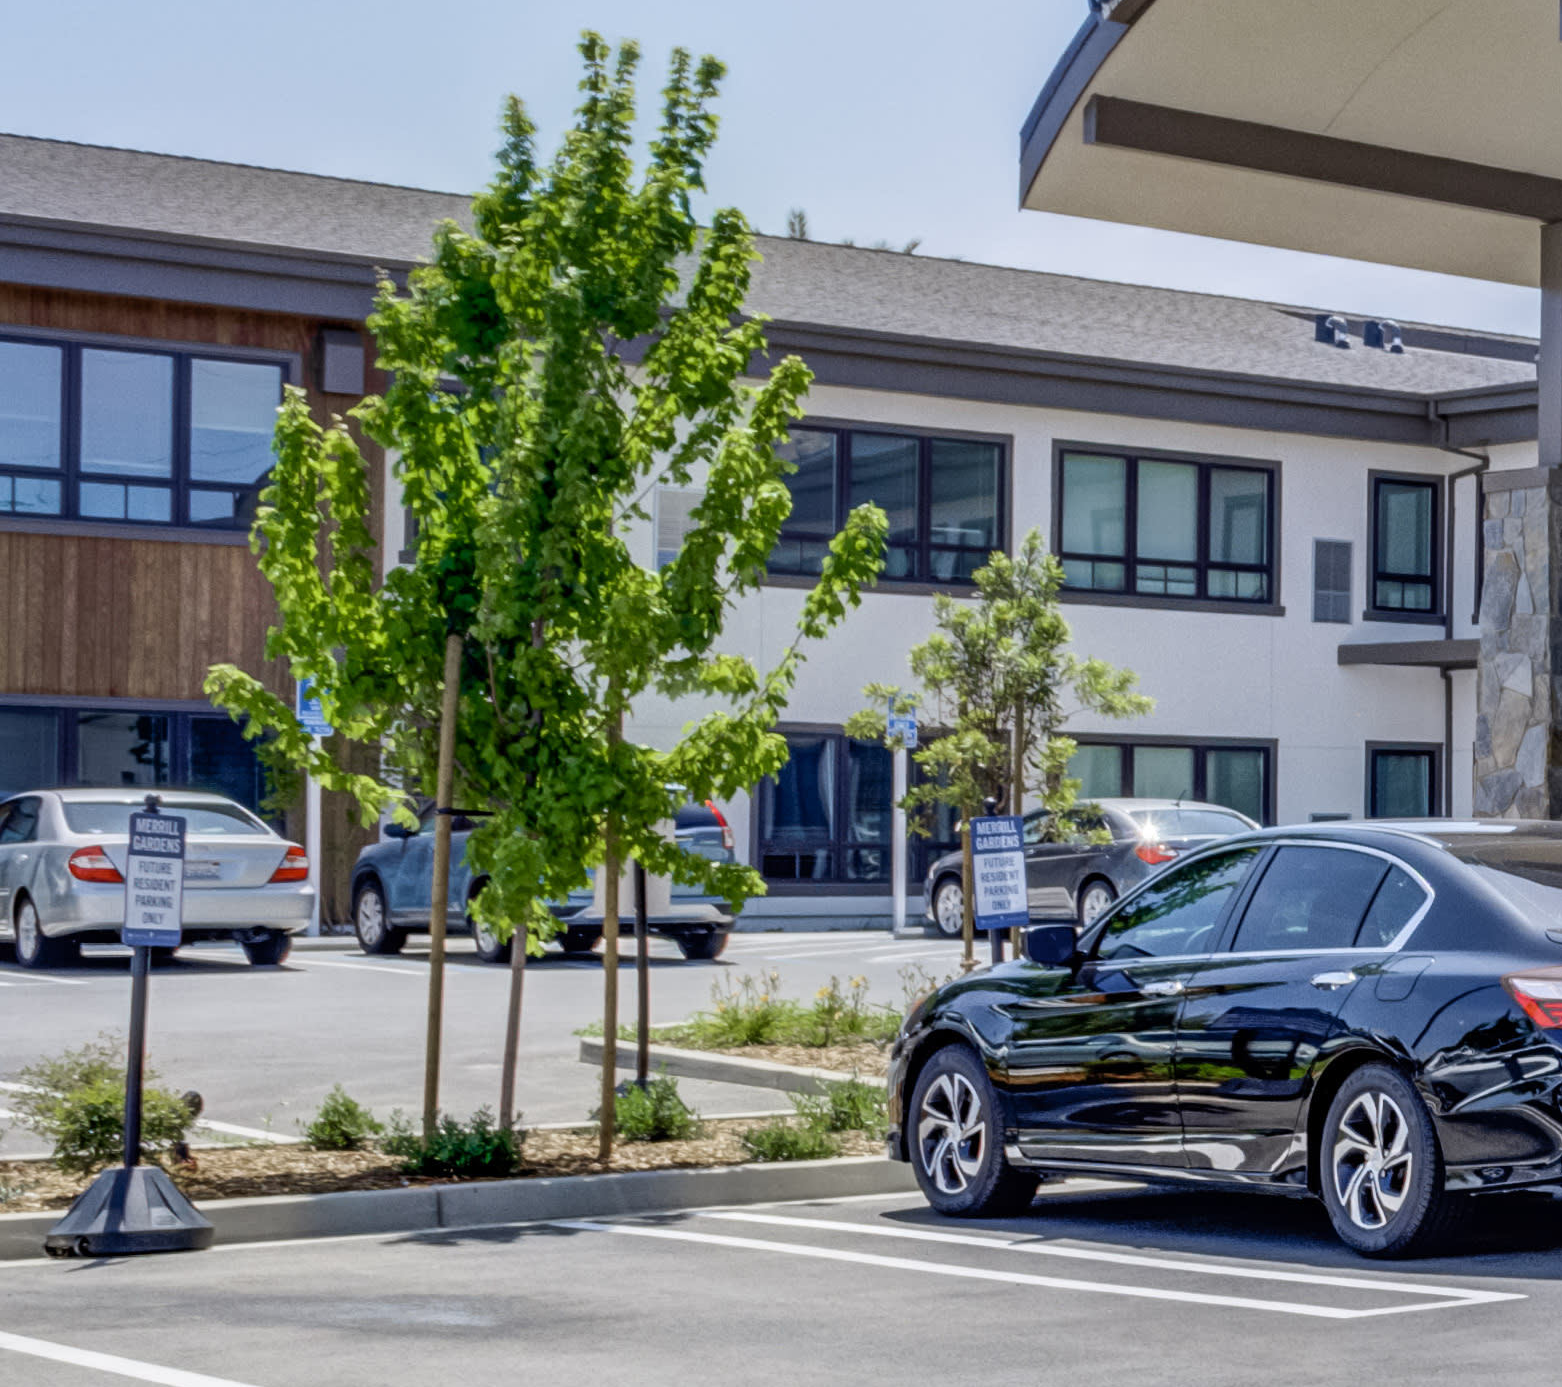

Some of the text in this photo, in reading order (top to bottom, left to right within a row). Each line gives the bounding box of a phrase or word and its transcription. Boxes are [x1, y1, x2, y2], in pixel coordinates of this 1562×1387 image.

[135, 817, 180, 835] MERRILL
[976, 820, 1017, 834] MERRILL
[132, 835, 181, 853] GARDENS
[975, 835, 1020, 850] GARDENS
[139, 861, 173, 874] FUTURE
[983, 856, 1015, 867] FUTURE
[980, 870, 1019, 883] RESIDENT
[133, 878, 177, 892] RESIDENT
[984, 885, 1019, 897] PARKING
[135, 895, 174, 909] PARKING
[992, 900, 1011, 910] ONLY
[142, 912, 165, 924] ONLY
